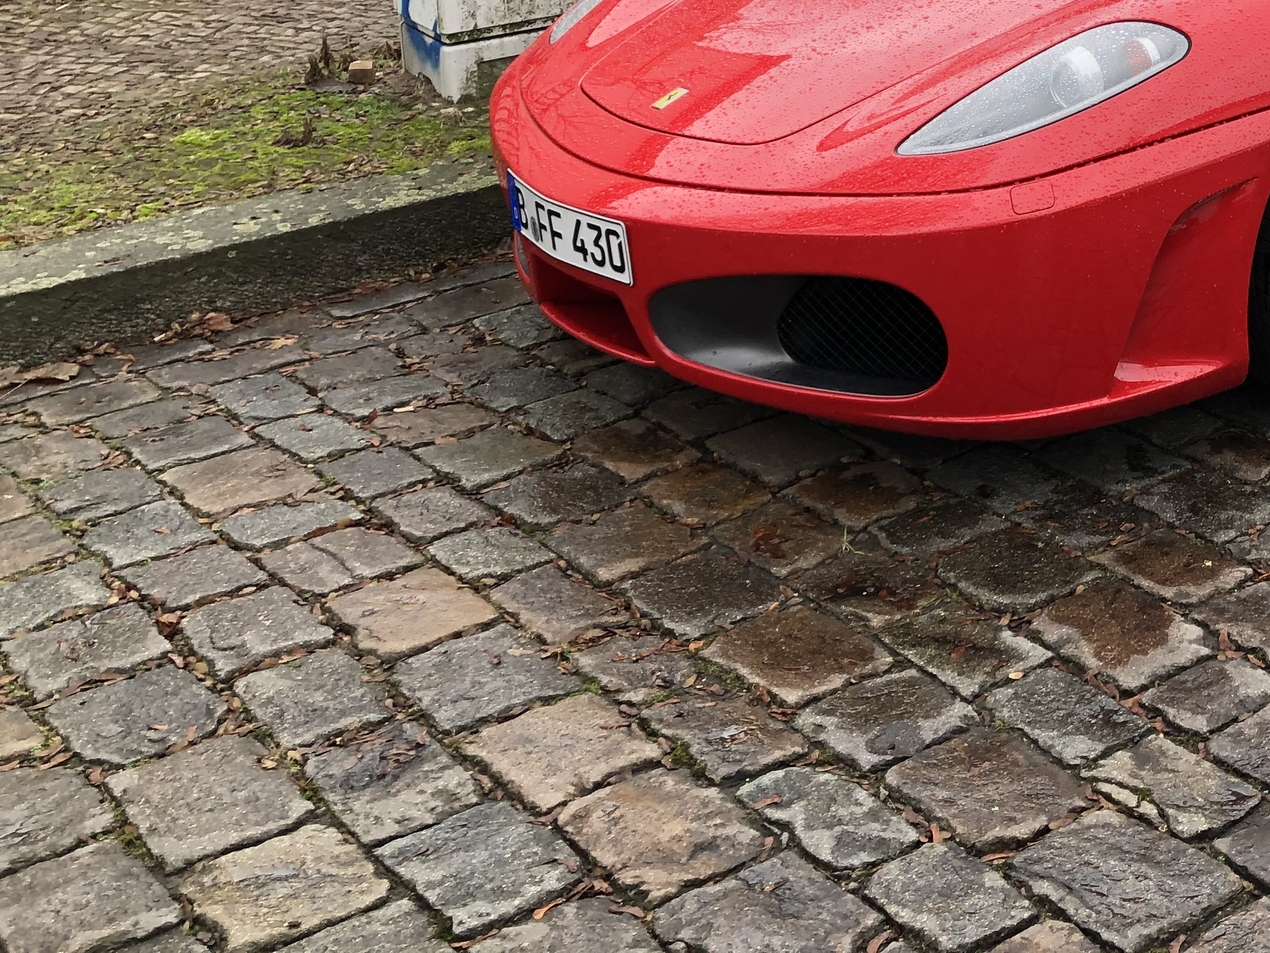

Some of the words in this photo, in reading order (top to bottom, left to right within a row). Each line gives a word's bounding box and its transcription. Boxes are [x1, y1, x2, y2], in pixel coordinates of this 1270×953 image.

[515, 185, 529, 230] B
[535, 200, 563, 250] FF
[572, 218, 625, 274] 430
